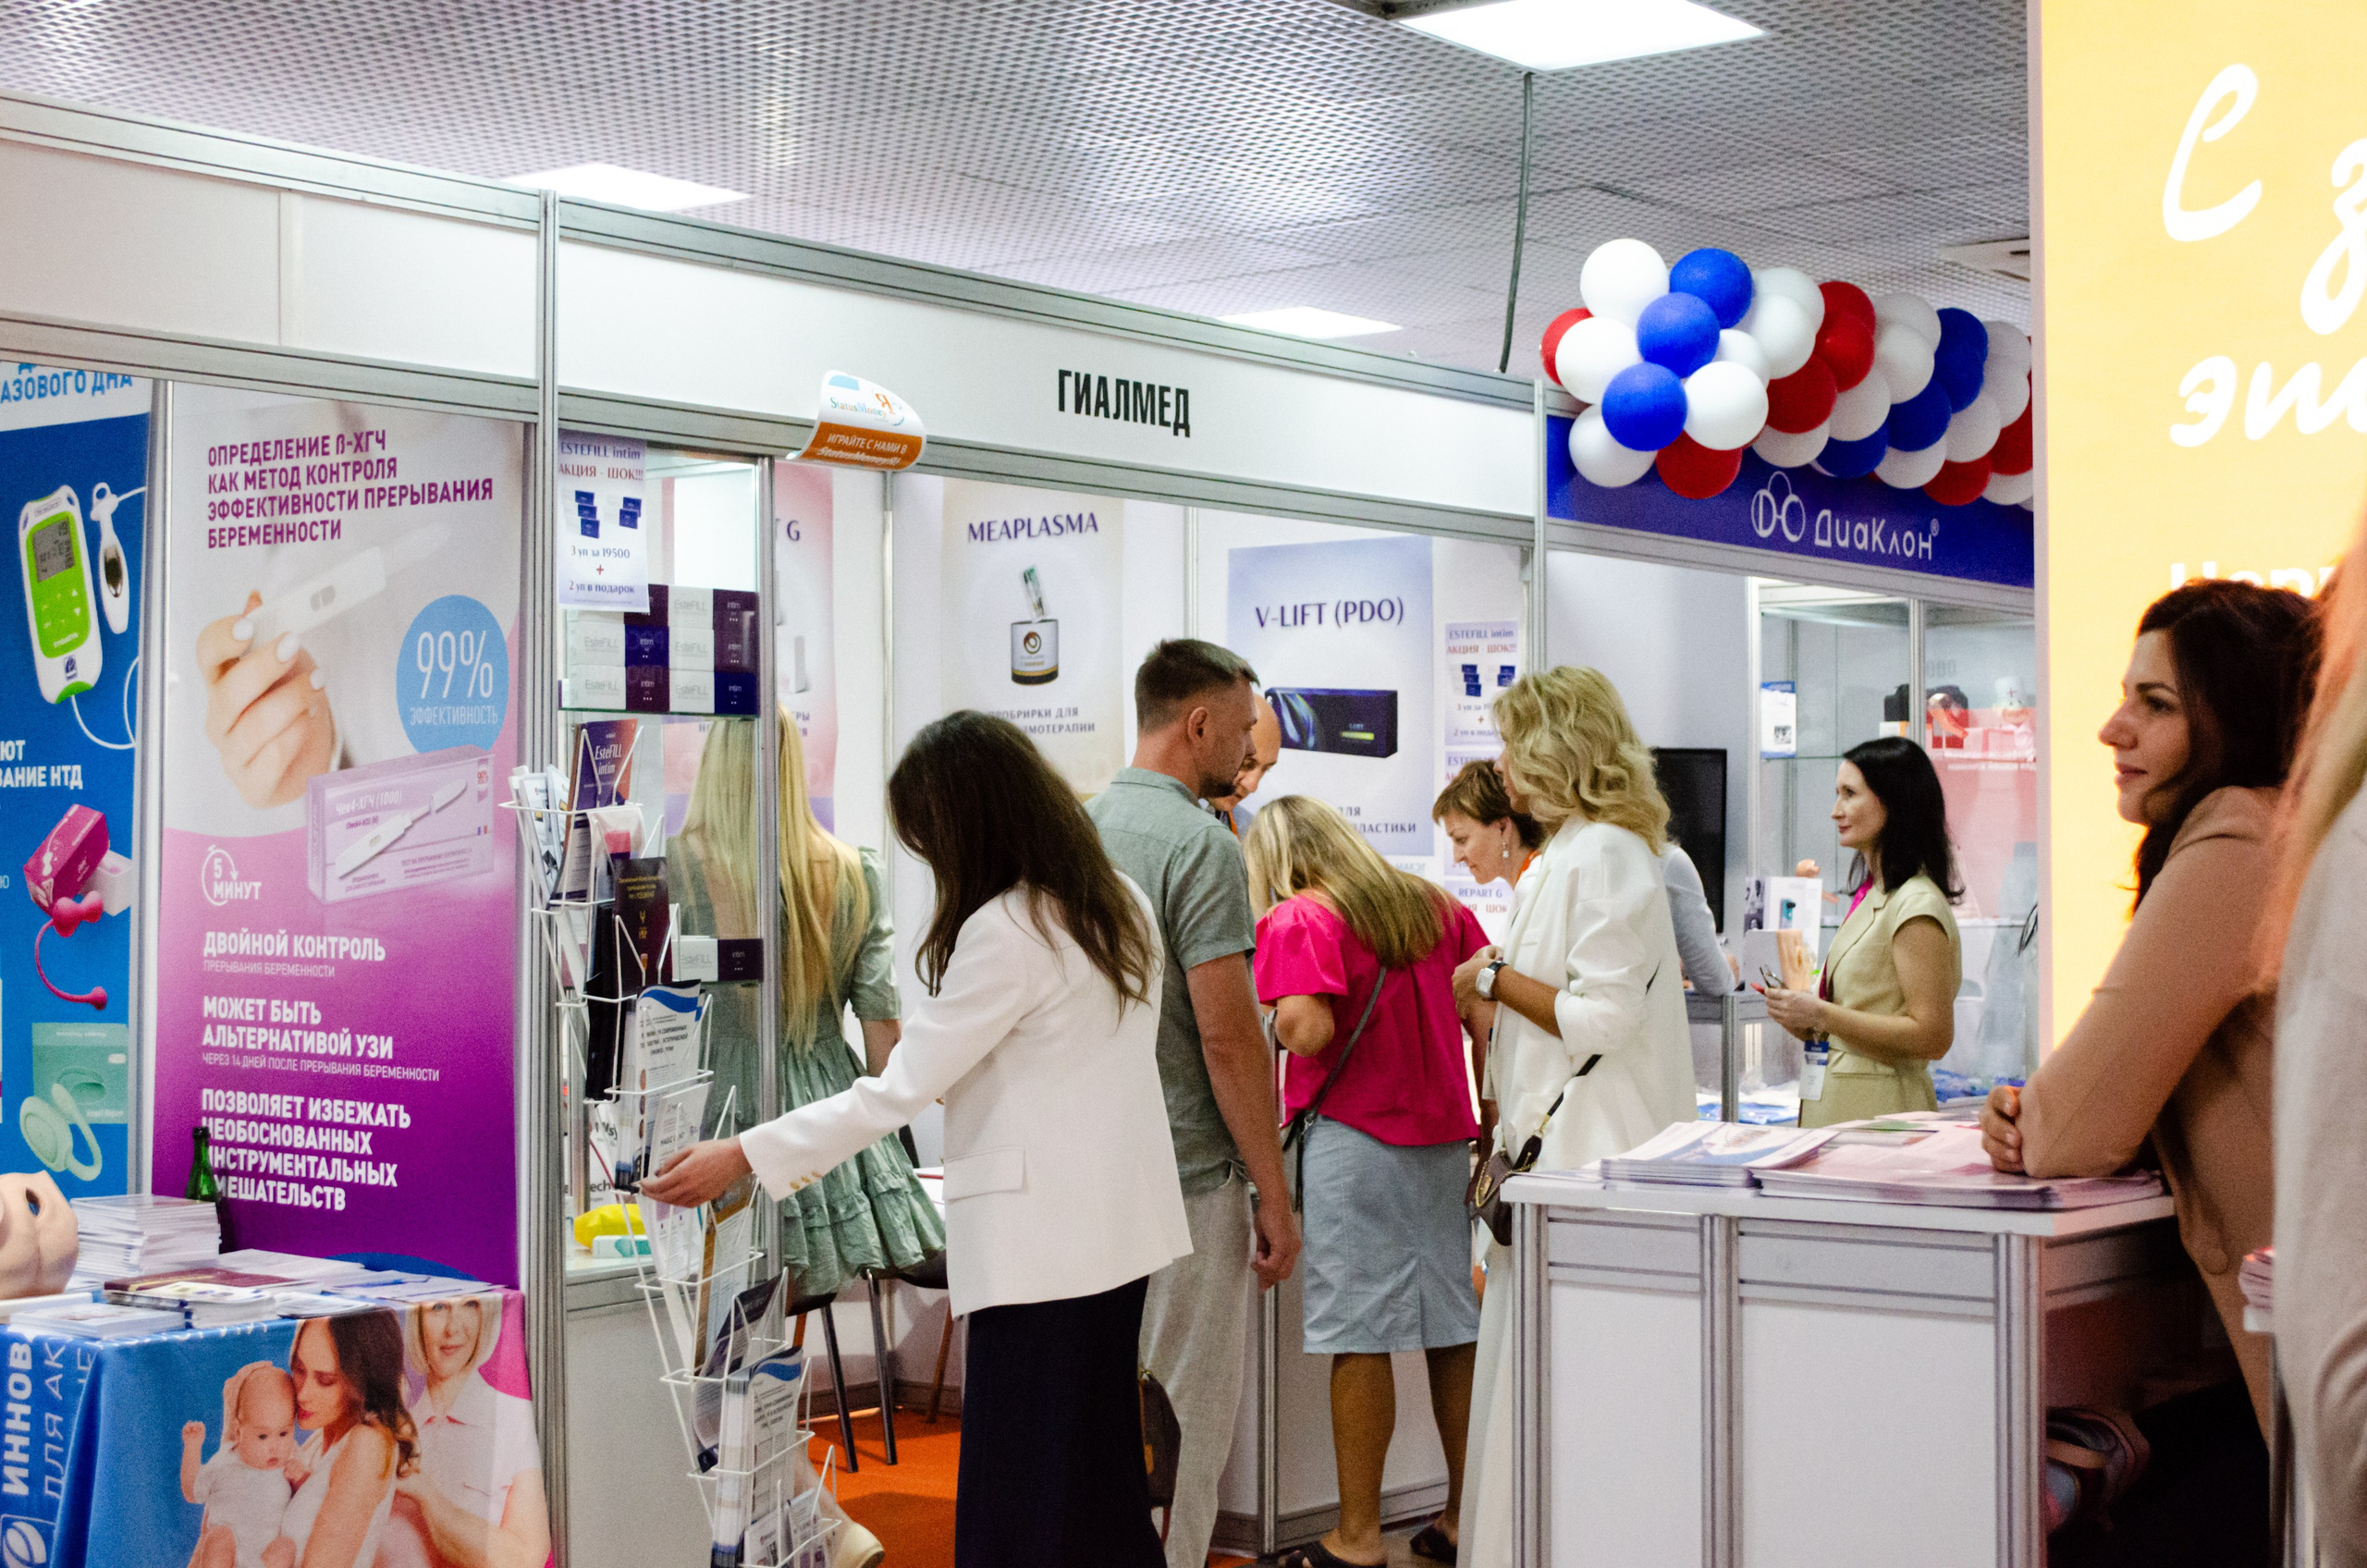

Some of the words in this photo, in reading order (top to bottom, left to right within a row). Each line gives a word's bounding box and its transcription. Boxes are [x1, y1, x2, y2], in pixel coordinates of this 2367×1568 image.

[1059, 369, 1190, 438] ГИАЛМЕД
[208, 435, 330, 466] ОПРЕДЕЛЕНИЕ
[560, 442, 610, 457] ESTEFILL
[613, 446, 641, 459] intim
[827, 434, 866, 448] ИГРАЙТЕ
[866, 440, 874, 449] С
[874, 440, 901, 453] НАМИ
[901, 445, 908, 454] В
[208, 472, 239, 494] КАК
[244, 466, 301, 491] МЕТОД
[306, 458, 397, 485] КОНТРОЛЯ
[558, 463, 596, 478] АКЦИЯ
[607, 467, 644, 481] ШОК!!!
[208, 489, 358, 521] ЭФФЕКТИВНОСТИ
[364, 478, 493, 508] ПРЕРЫВАНИЯ
[208, 519, 341, 549] БЕРЕМЕННОСТИ
[787, 520, 801, 542] G
[968, 512, 1098, 543] MEAPLASMA
[571, 545, 576, 556] 3
[578, 548, 588, 558] уп
[603, 548, 631, 558] 19500
[569, 580, 574, 591] 2
[595, 584, 635, 594] подарок
[1255, 603, 1327, 630] V-LIFT
[1334, 597, 1404, 629] (PDO)
[1449, 629, 1488, 640] ESTEFILL
[1491, 629, 1514, 638] intim
[1447, 645, 1478, 655] АКЦИЯ
[417, 631, 494, 698] 99%
[410, 706, 498, 726] ЭФФЕКТИВНОСТЬ
[1055, 707, 1079, 719] ДЛЯ
[595, 743, 622, 760] EsteFILL
[50, 765, 83, 790] НТД
[214, 858, 222, 878] 5
[214, 881, 262, 900] МИНУТ
[1458, 888, 1492, 898] REPART
[1496, 888, 1502, 898] G
[203, 928, 288, 957] ДВОЙНОЙ
[293, 935, 386, 961] КОНТРОЛЬ
[203, 960, 263, 974] ПРЕРЫВАНИЯ
[264, 962, 335, 977] БЕРЕМЕННОСТИ
[203, 996, 266, 1022] МОЖЕТ
[271, 999, 322, 1025] БЫТЬ
[202, 1023, 351, 1058] АЛЬТЕРНАТИВОЙ
[356, 1035, 393, 1060] УЗИ
[202, 1052, 229, 1066] ЧЕРЕЗ
[232, 1054, 240, 1067] 14
[242, 1054, 266, 1070] ДНЕЙ
[268, 1057, 298, 1072] ПОСЛЕ
[300, 1059, 362, 1076] ПРЕРЫВАНИЯ
[363, 1063, 440, 1082] БЕРЕМЕННОСТИ
[202, 1088, 304, 1120] ПОЗВОЛЯЕТ
[309, 1097, 411, 1129] ИЗБЕЖАТЬ
[215, 1175, 346, 1212] МЕШАТЕЛЬСТВ
[2, 1341, 32, 1496] ИННОВ
